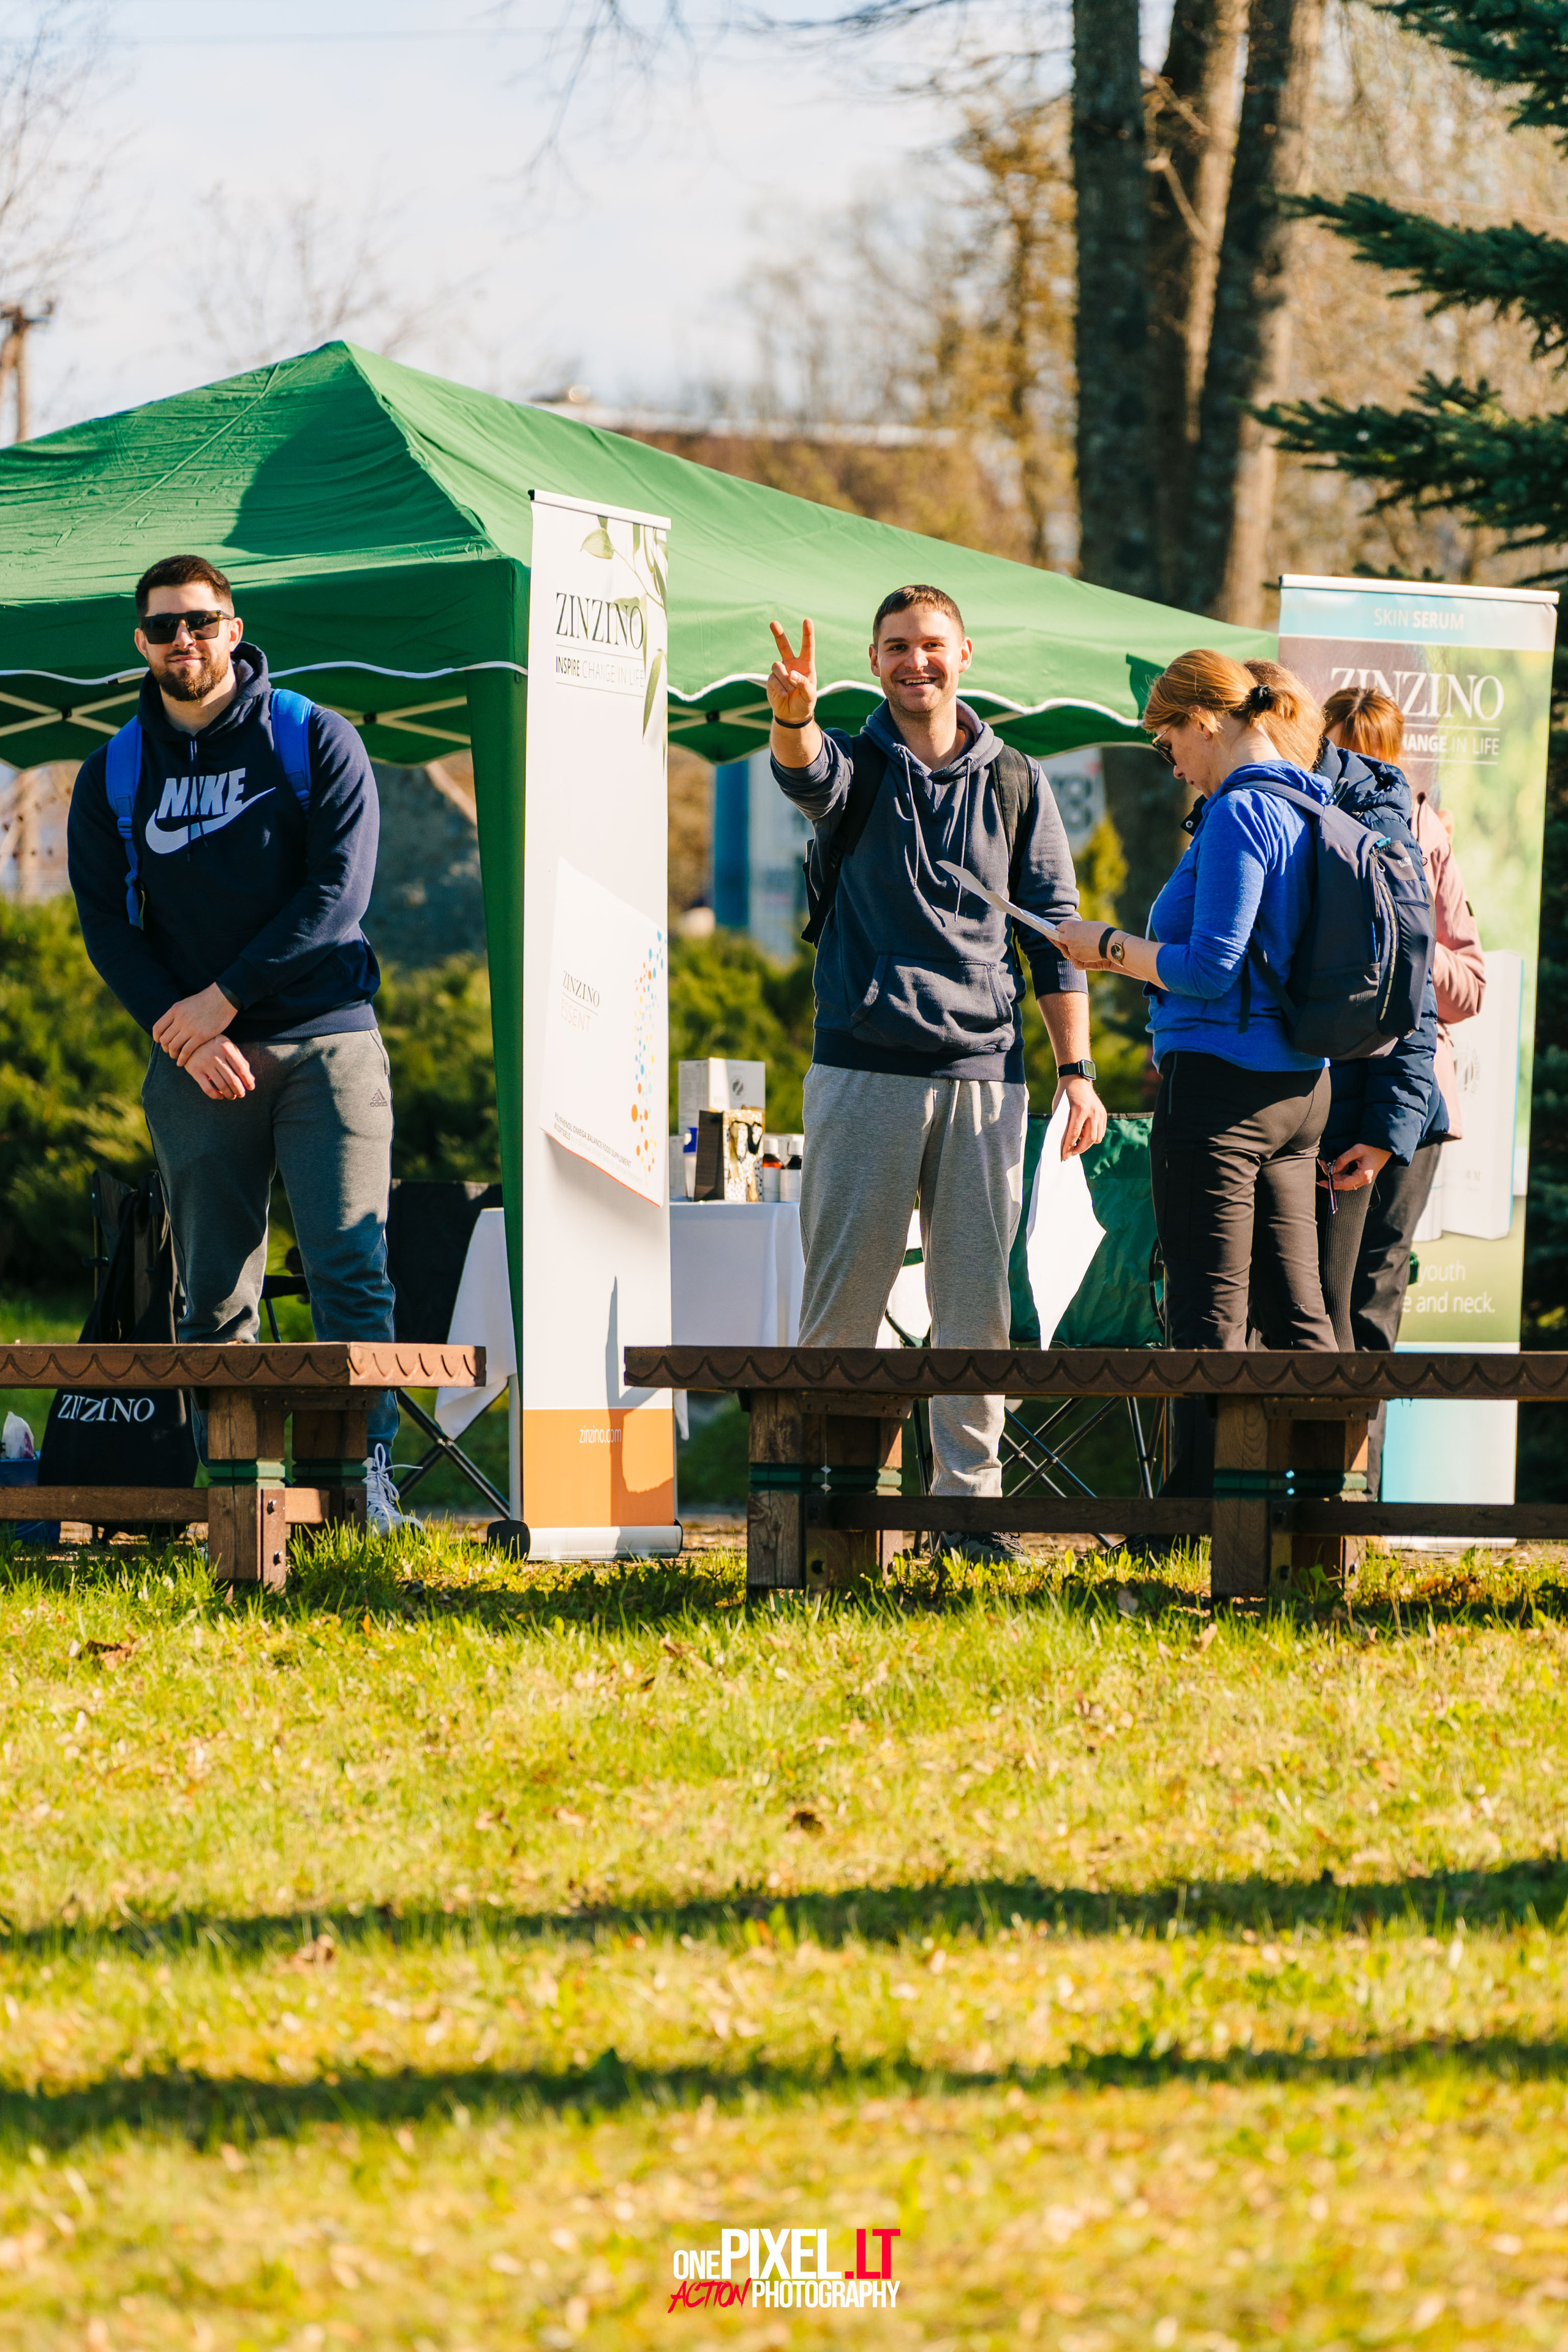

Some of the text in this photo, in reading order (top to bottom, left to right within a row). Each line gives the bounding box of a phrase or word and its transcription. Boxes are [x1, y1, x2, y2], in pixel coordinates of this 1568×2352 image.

[556, 592, 644, 649] ZINZINO
[1374, 608, 1464, 631] SKIN SERUM
[556, 656, 644, 687] INSPIRE CHANGE IN LIFE
[1401, 733, 1500, 756] ANGE IN LIFE
[157, 767, 246, 820] NIKE
[563, 970, 600, 1008] ZINZINO
[573, 1125, 587, 1139] OMEGA
[1418, 1259, 1466, 1287] youth
[1416, 1291, 1449, 1313] and
[1453, 1290, 1496, 1314] neck.
[579, 1425, 622, 1444] zinzino.com
